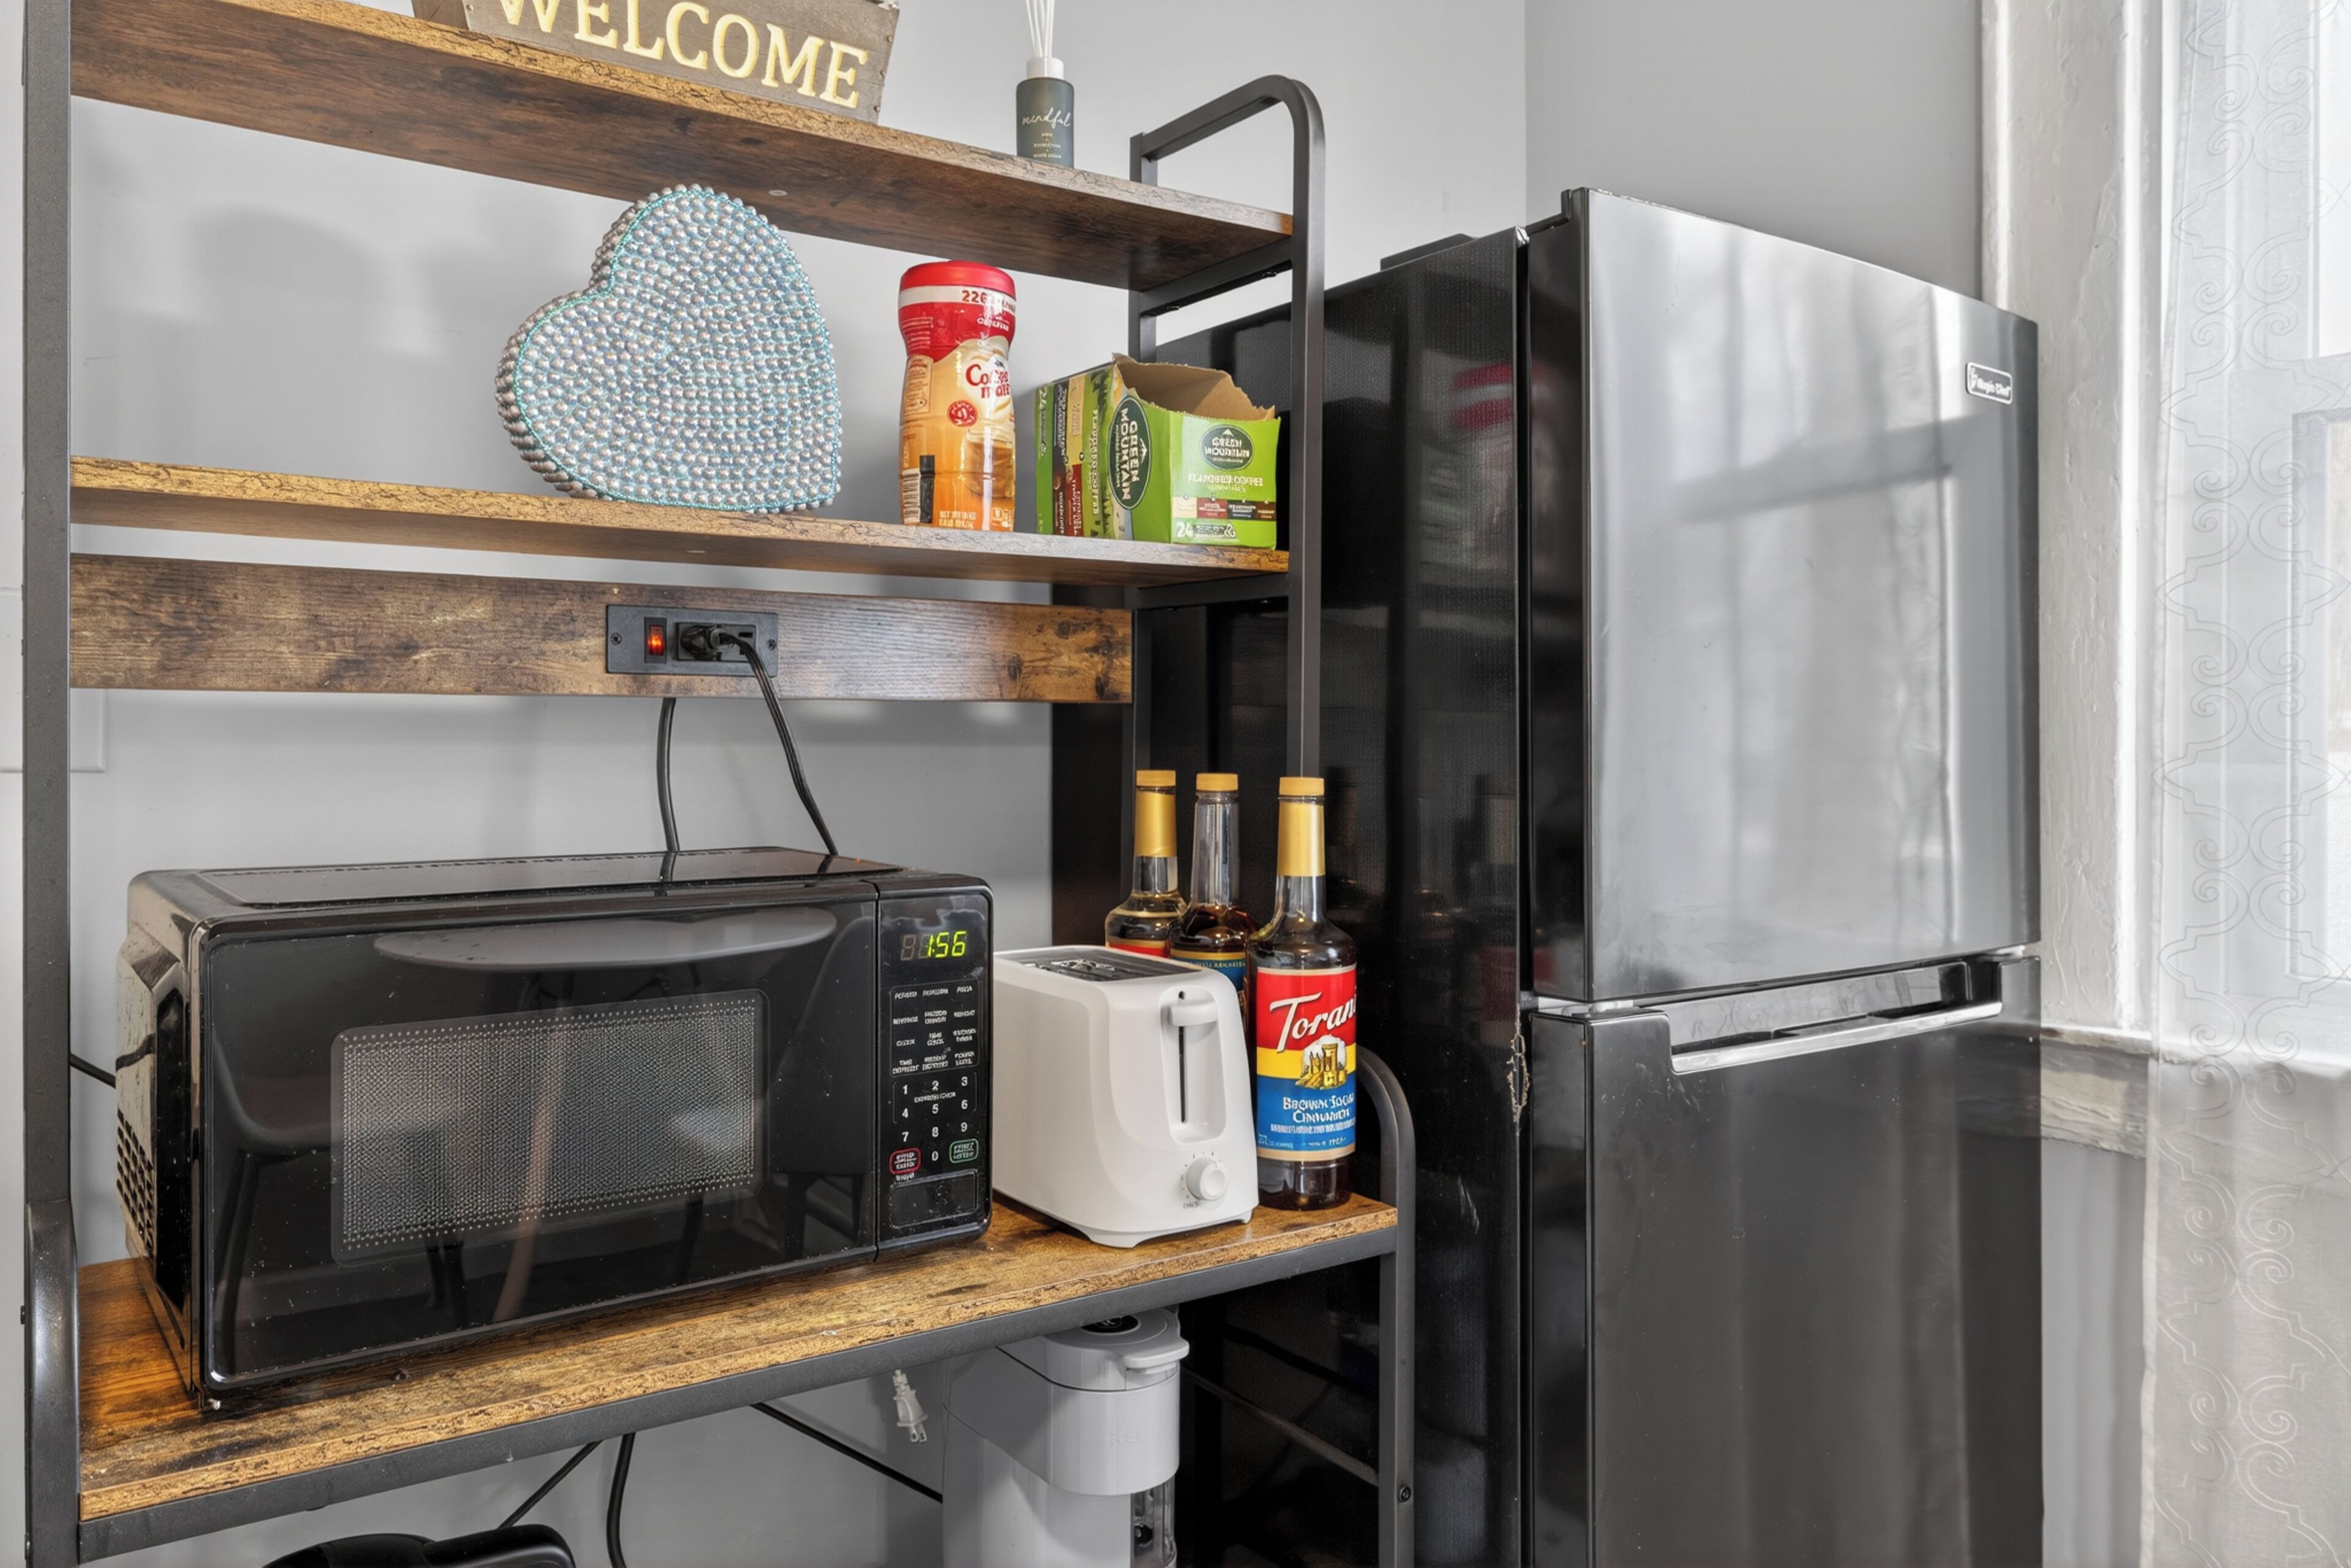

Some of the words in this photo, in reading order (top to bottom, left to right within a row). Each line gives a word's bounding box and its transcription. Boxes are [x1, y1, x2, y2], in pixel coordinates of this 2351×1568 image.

[497, 0, 868, 108] WELCOME
[1022, 107, 1071, 129] mindful
[966, 364, 1010, 386] Coee
[1120, 407, 1131, 500] MOUNTAIN
[1129, 420, 1140, 483] GREEN
[1177, 522, 1193, 538] 24
[902, 1084, 908, 1095] 1
[931, 1080, 939, 1091] 2
[961, 1076, 968, 1086] 3
[902, 1108, 909, 1118] 4
[932, 1103, 939, 1114] 5
[961, 1100, 968, 1109] 6
[902, 1131, 909, 1142] 7
[931, 1127, 939, 1137] 8
[961, 1122, 967, 1132] 9
[931, 1150, 939, 1161] 0
